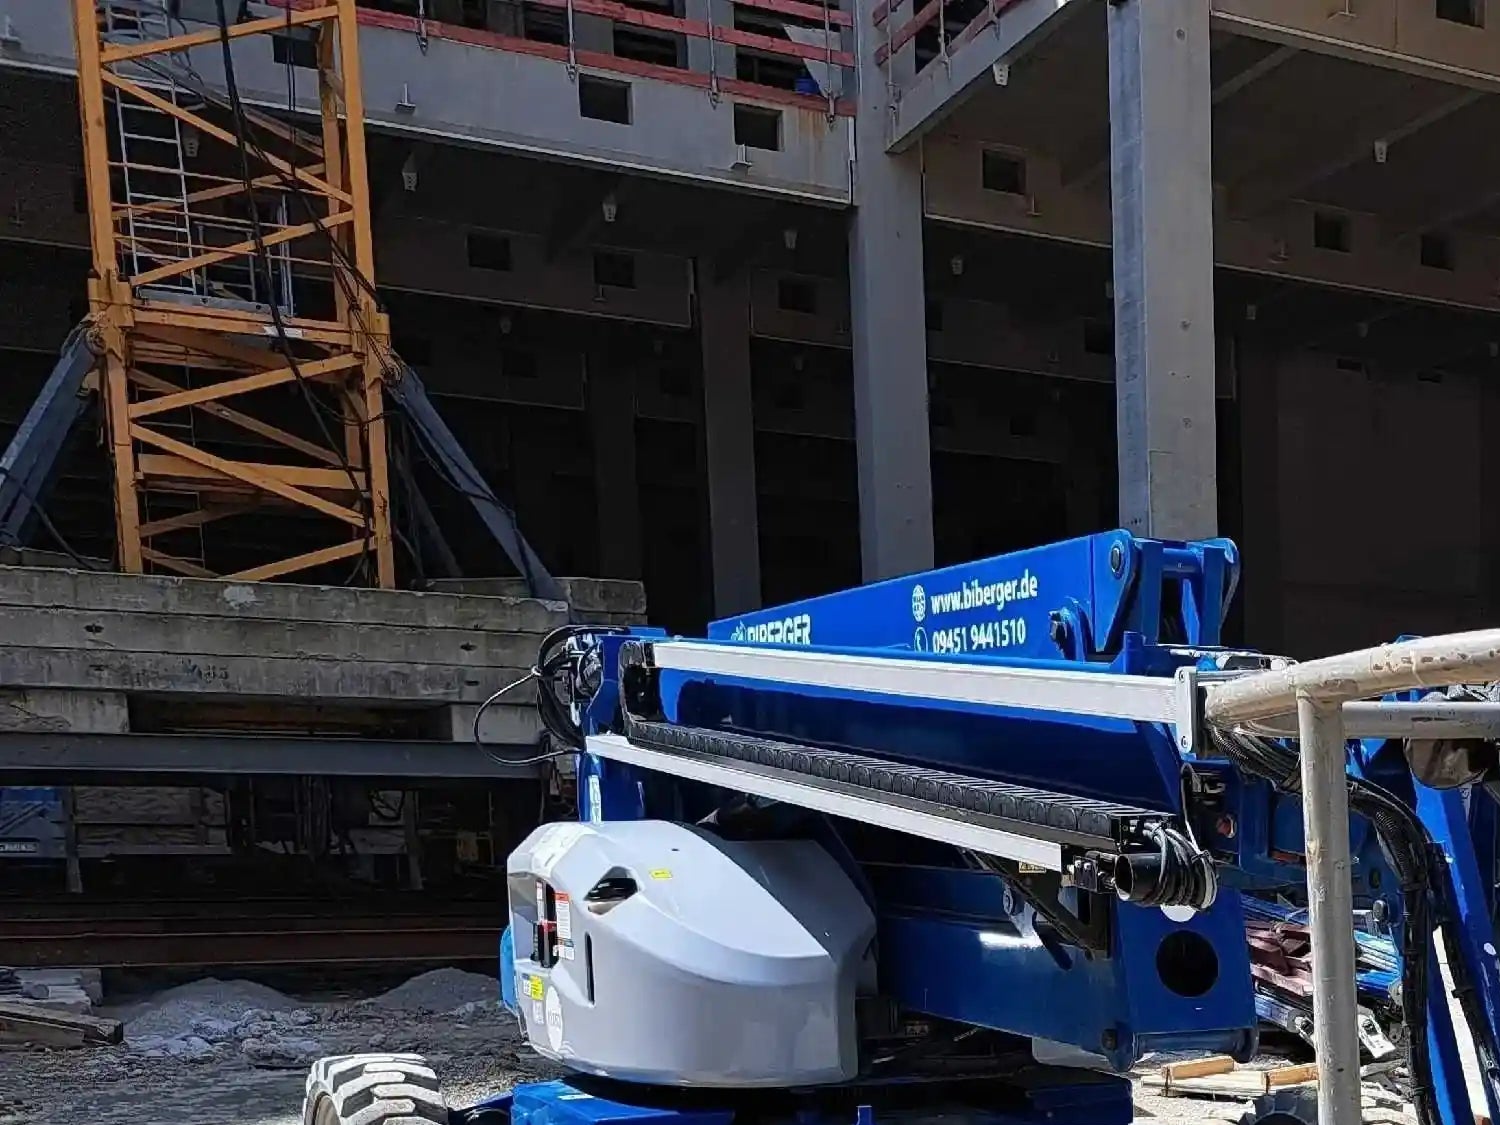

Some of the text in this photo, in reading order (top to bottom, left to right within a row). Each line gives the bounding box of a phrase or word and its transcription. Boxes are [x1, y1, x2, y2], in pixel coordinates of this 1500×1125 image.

[931, 569, 1038, 614] www.biberger.de
[932, 618, 1026, 654] 09451 9441510
